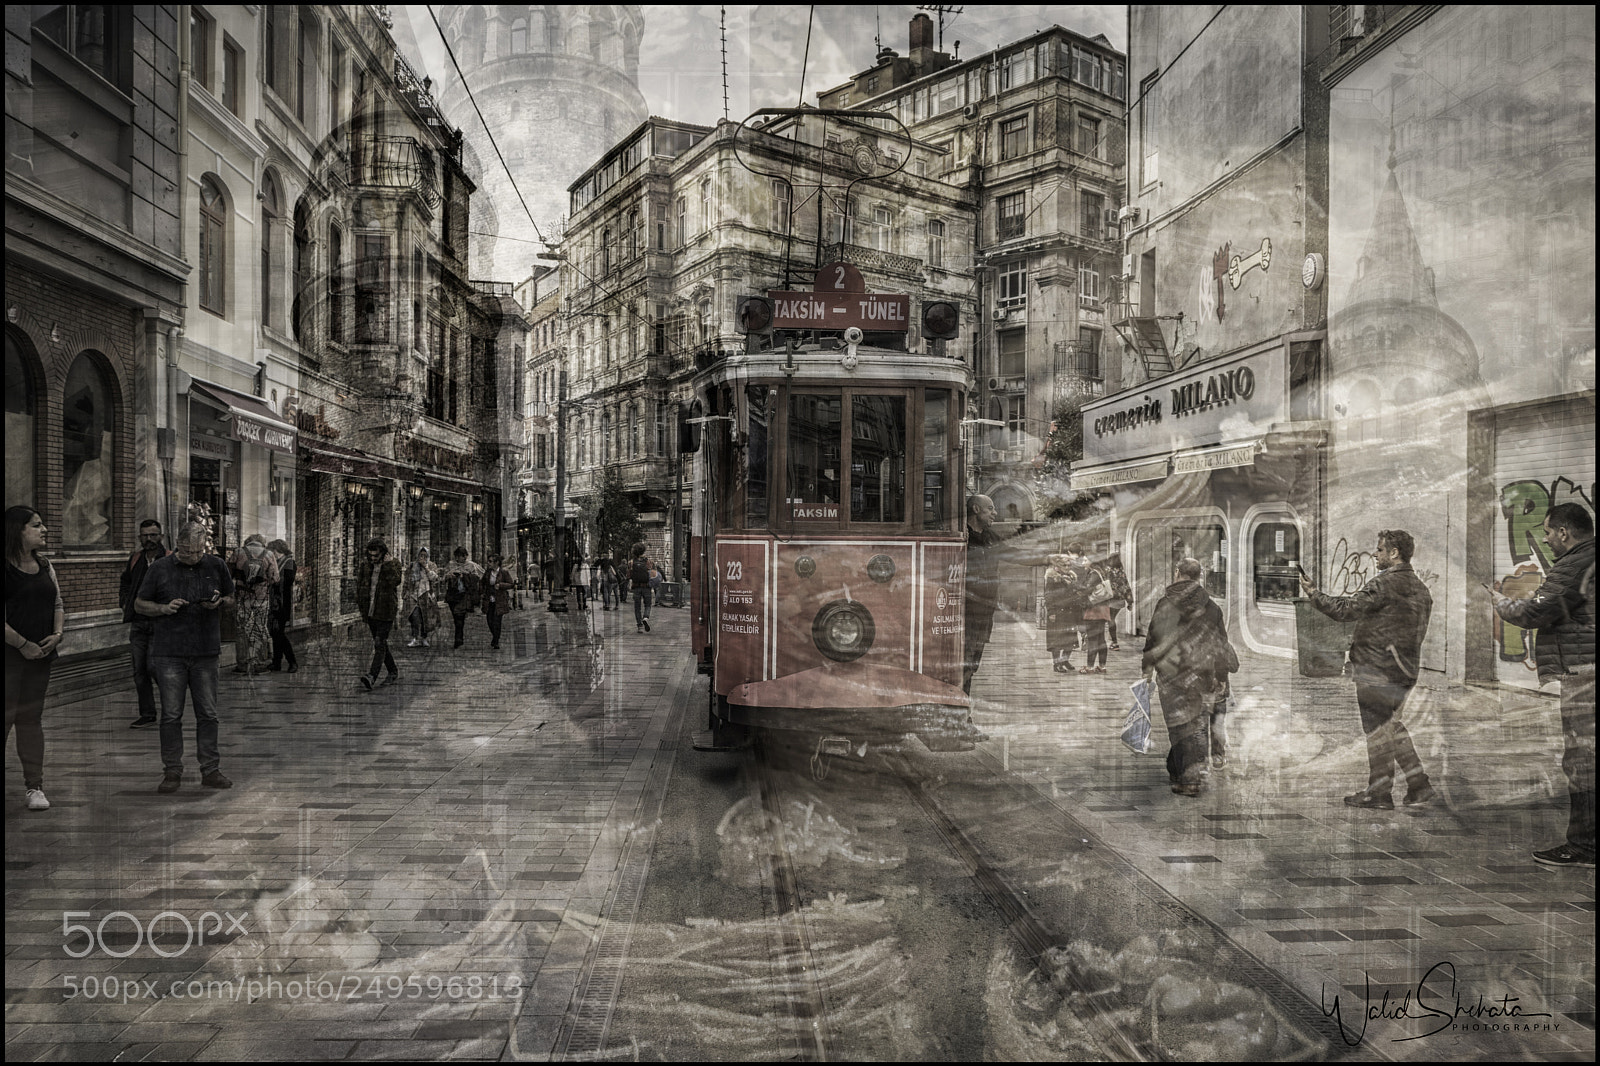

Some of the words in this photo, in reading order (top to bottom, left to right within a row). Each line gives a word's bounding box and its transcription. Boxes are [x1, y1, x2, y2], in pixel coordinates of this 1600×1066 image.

[834, 266, 845, 289] 2
[774, 296, 825, 320] TAKSİM
[859, 296, 905, 321] TÜNEL
[1171, 365, 1256, 417] MILANO
[1214, 449, 1251, 467] MILANO
[1114, 468, 1139, 482] MILANO
[726, 561, 742, 580] 223
[739, 614, 758, 623] YASAK
